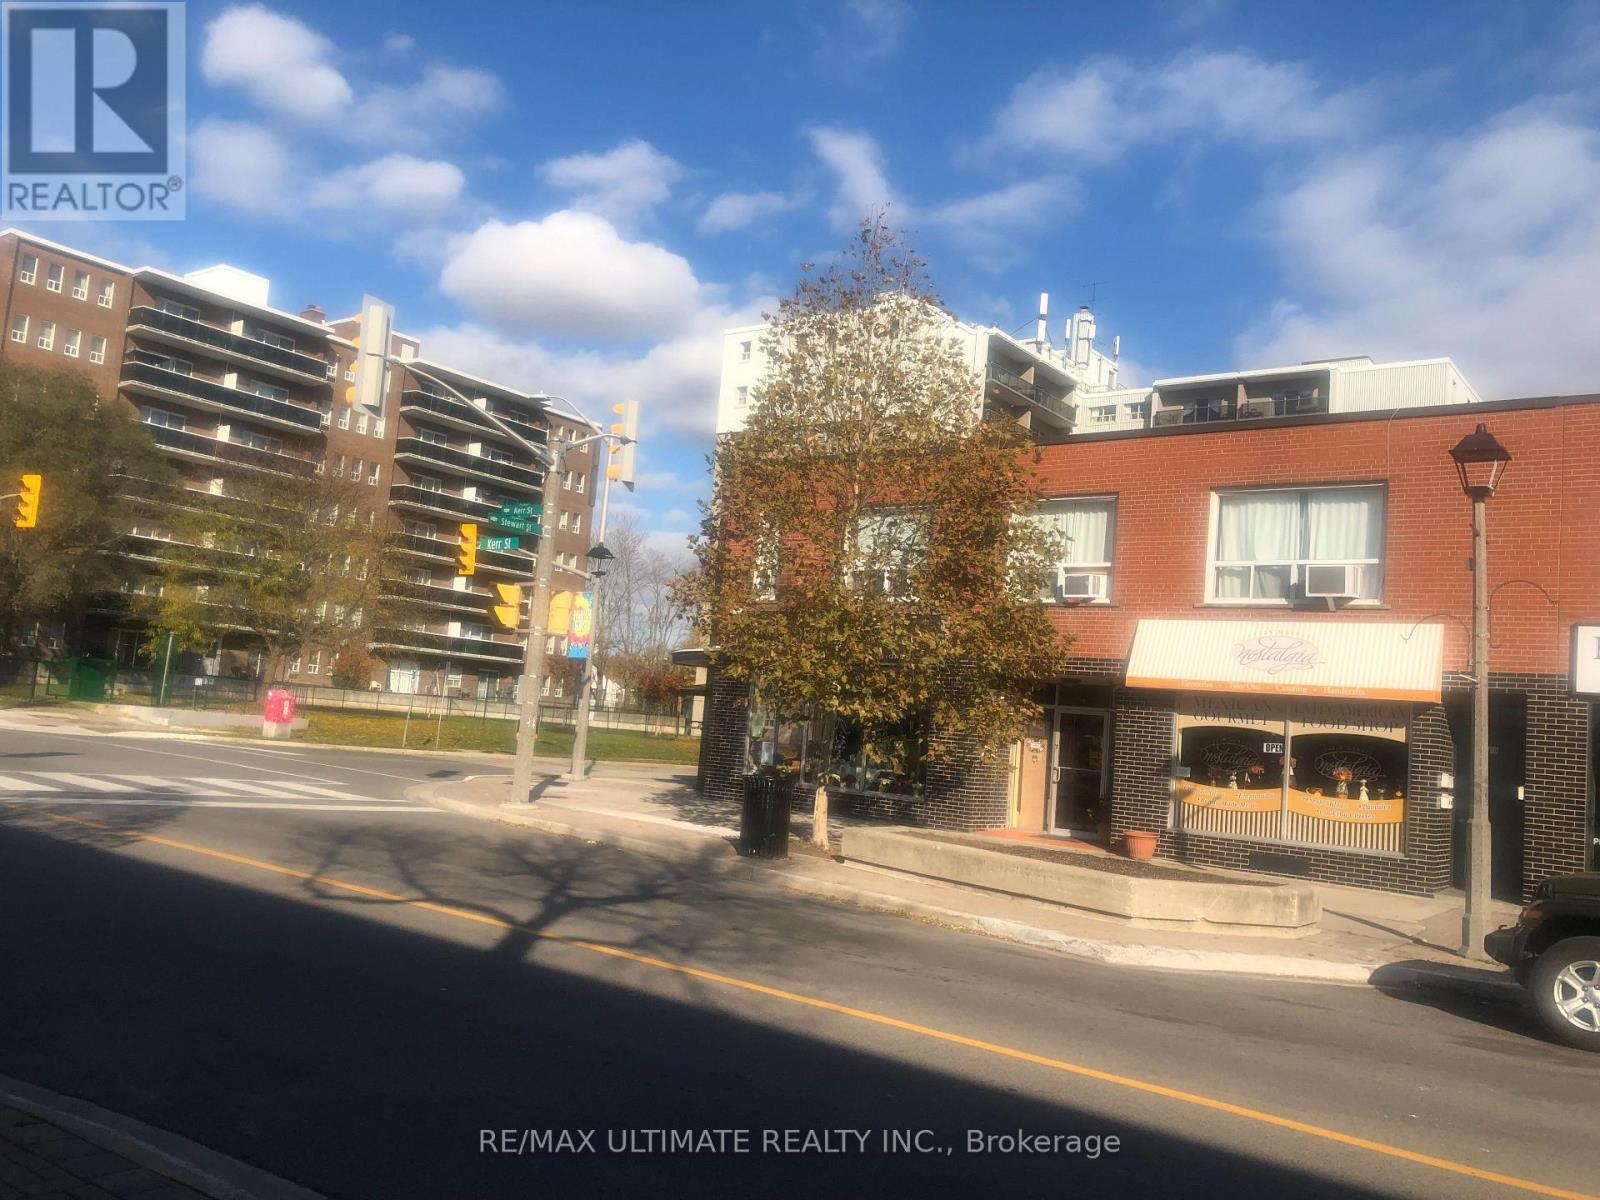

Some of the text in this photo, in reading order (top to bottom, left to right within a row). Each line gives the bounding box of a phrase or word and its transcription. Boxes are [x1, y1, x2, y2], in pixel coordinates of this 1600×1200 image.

[513, 505, 534, 515] Kerr St
[500, 517, 525, 529] Stewart
[526, 523, 532, 532] St
[487, 537, 511, 550] Kerr St
[1193, 711, 1268, 726] GOURMET
[1302, 717, 1399, 733] FOOD SHOP
[1265, 743, 1284, 753] OPEN
